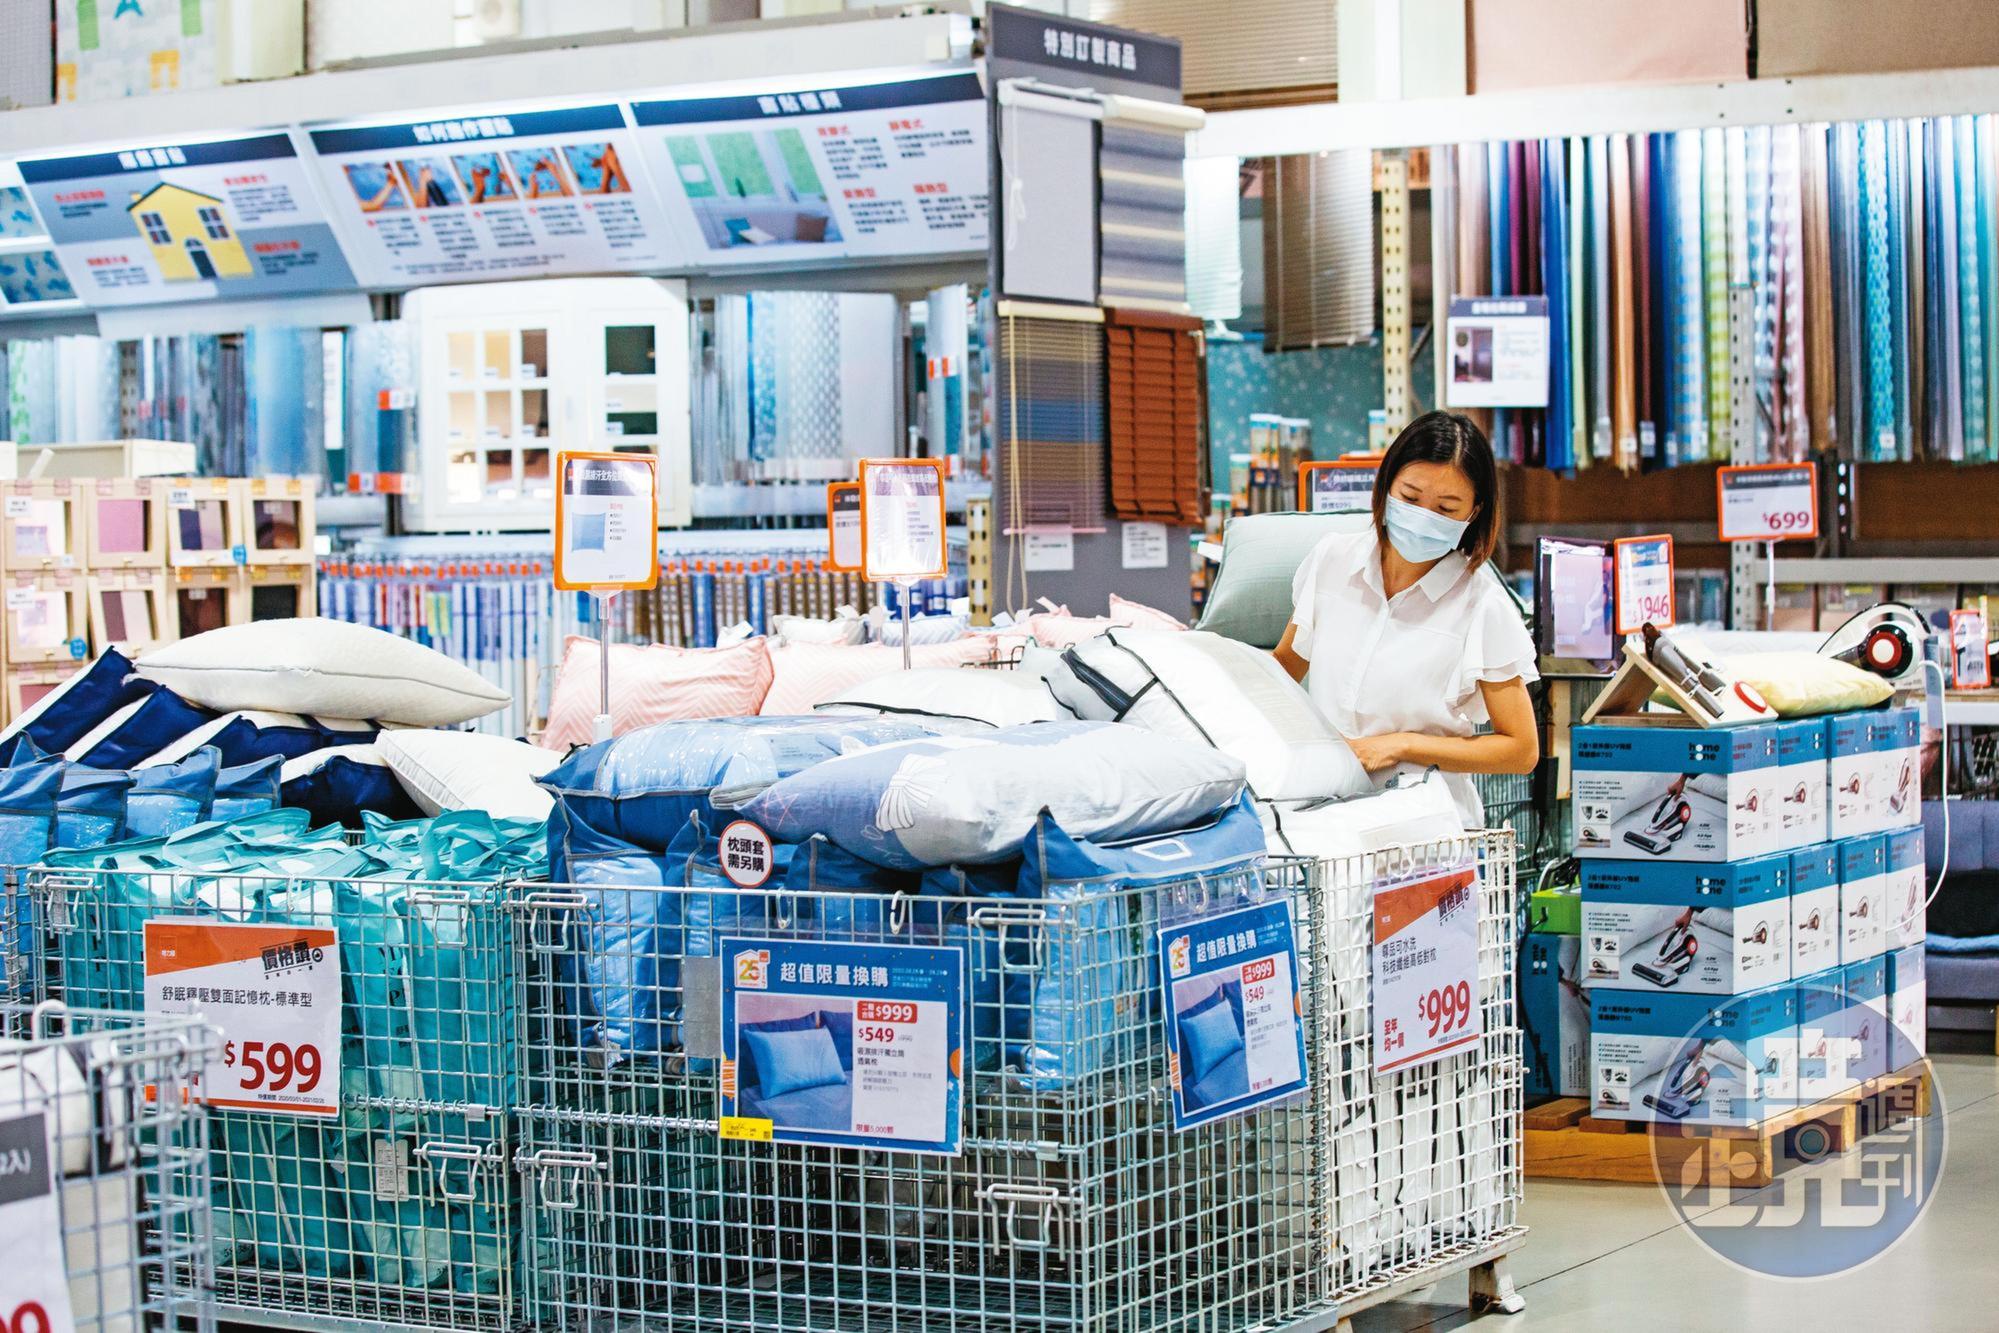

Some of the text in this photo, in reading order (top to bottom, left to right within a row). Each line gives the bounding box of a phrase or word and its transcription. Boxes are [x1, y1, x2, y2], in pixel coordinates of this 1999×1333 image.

[1762, 511, 1810, 530] $699
[727, 836, 764, 855] 枕頭套
[727, 854, 765, 872] 需另購
[1196, 929, 1258, 964] 超值限量換購
[739, 959, 761, 981] 25
[780, 962, 889, 988] 超值限量換購
[876, 1004, 913, 1022] $999
[1418, 980, 1471, 1038] $999
[858, 1027, 894, 1043] $549
[224, 1041, 322, 1093] $599
